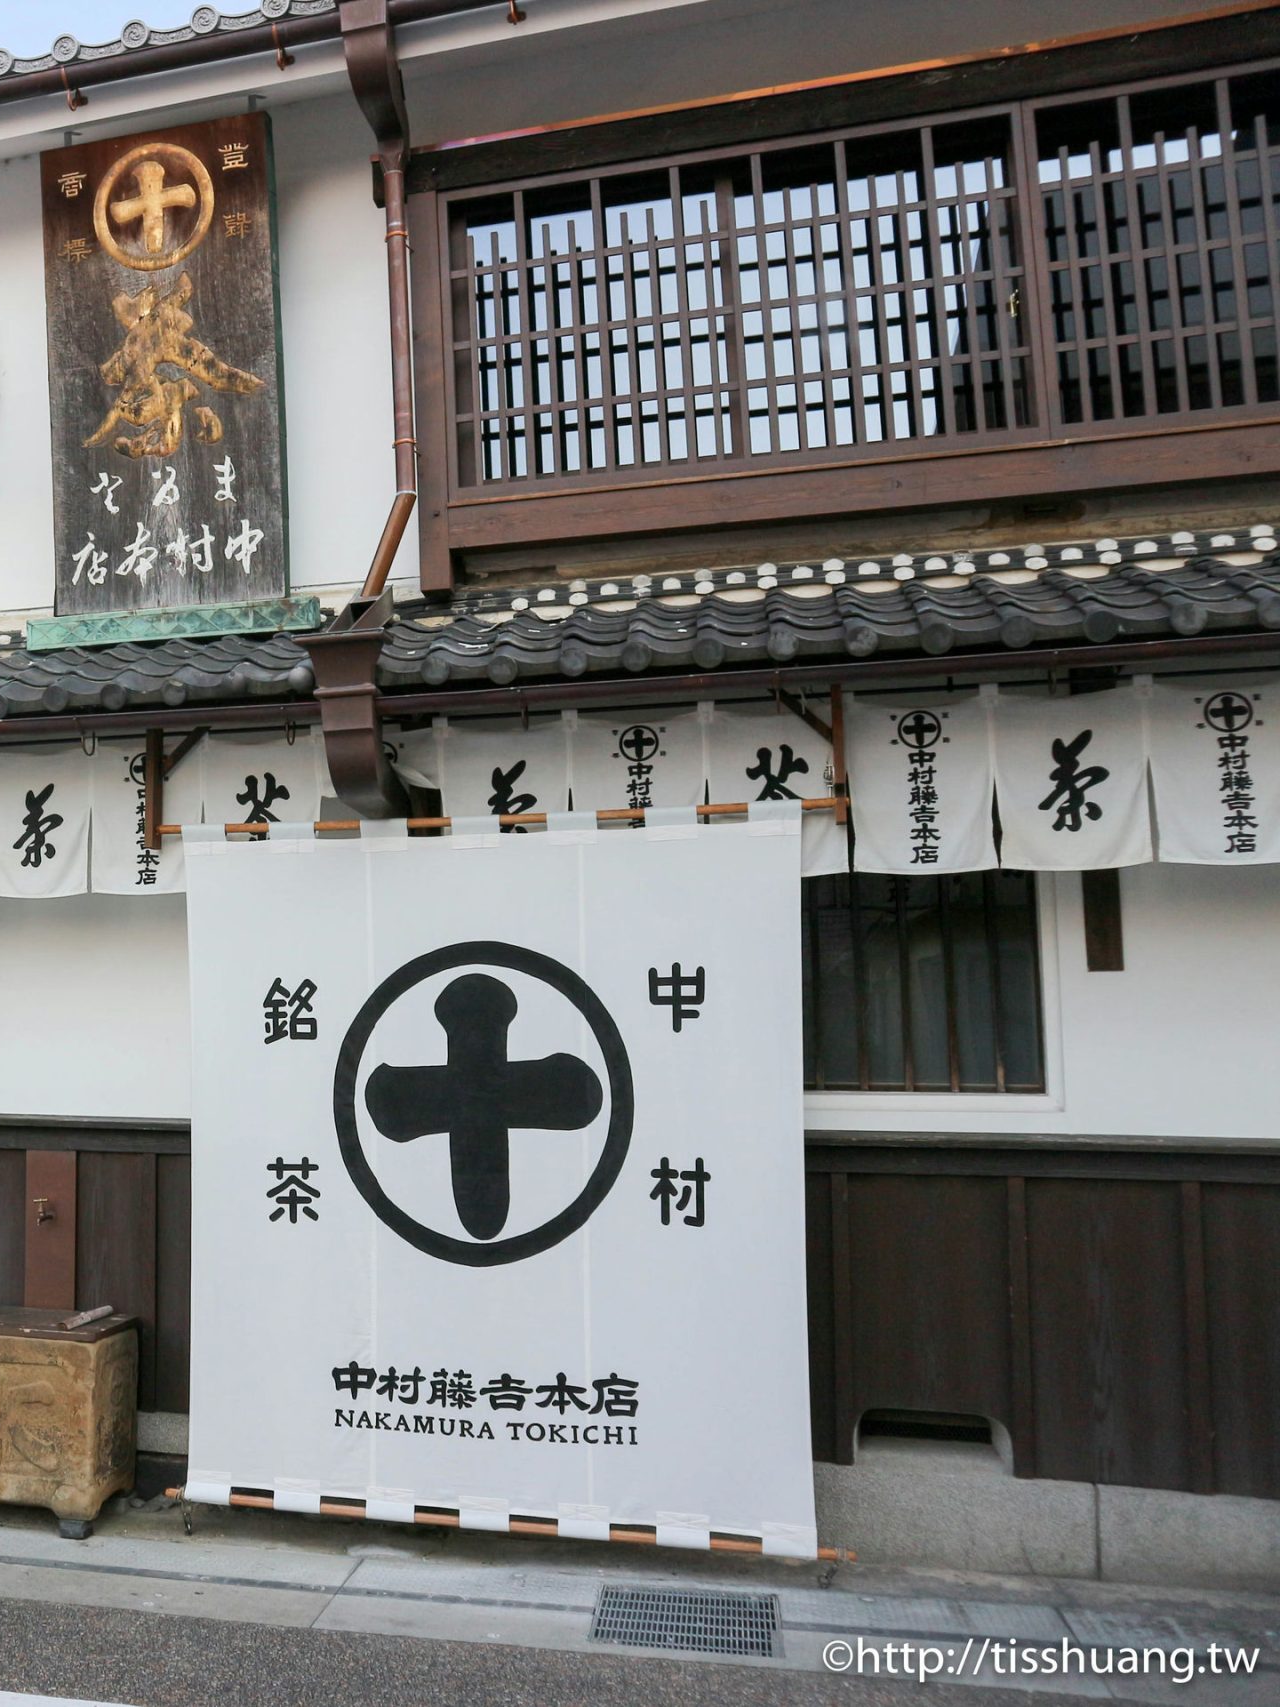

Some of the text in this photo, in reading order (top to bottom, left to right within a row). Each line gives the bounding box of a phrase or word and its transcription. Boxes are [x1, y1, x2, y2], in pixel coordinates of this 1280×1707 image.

[1038, 729, 1109, 831] 茶
[13, 783, 63, 867] 茶
[334, 1409, 639, 1446] NAKAMURA TOKICHI
